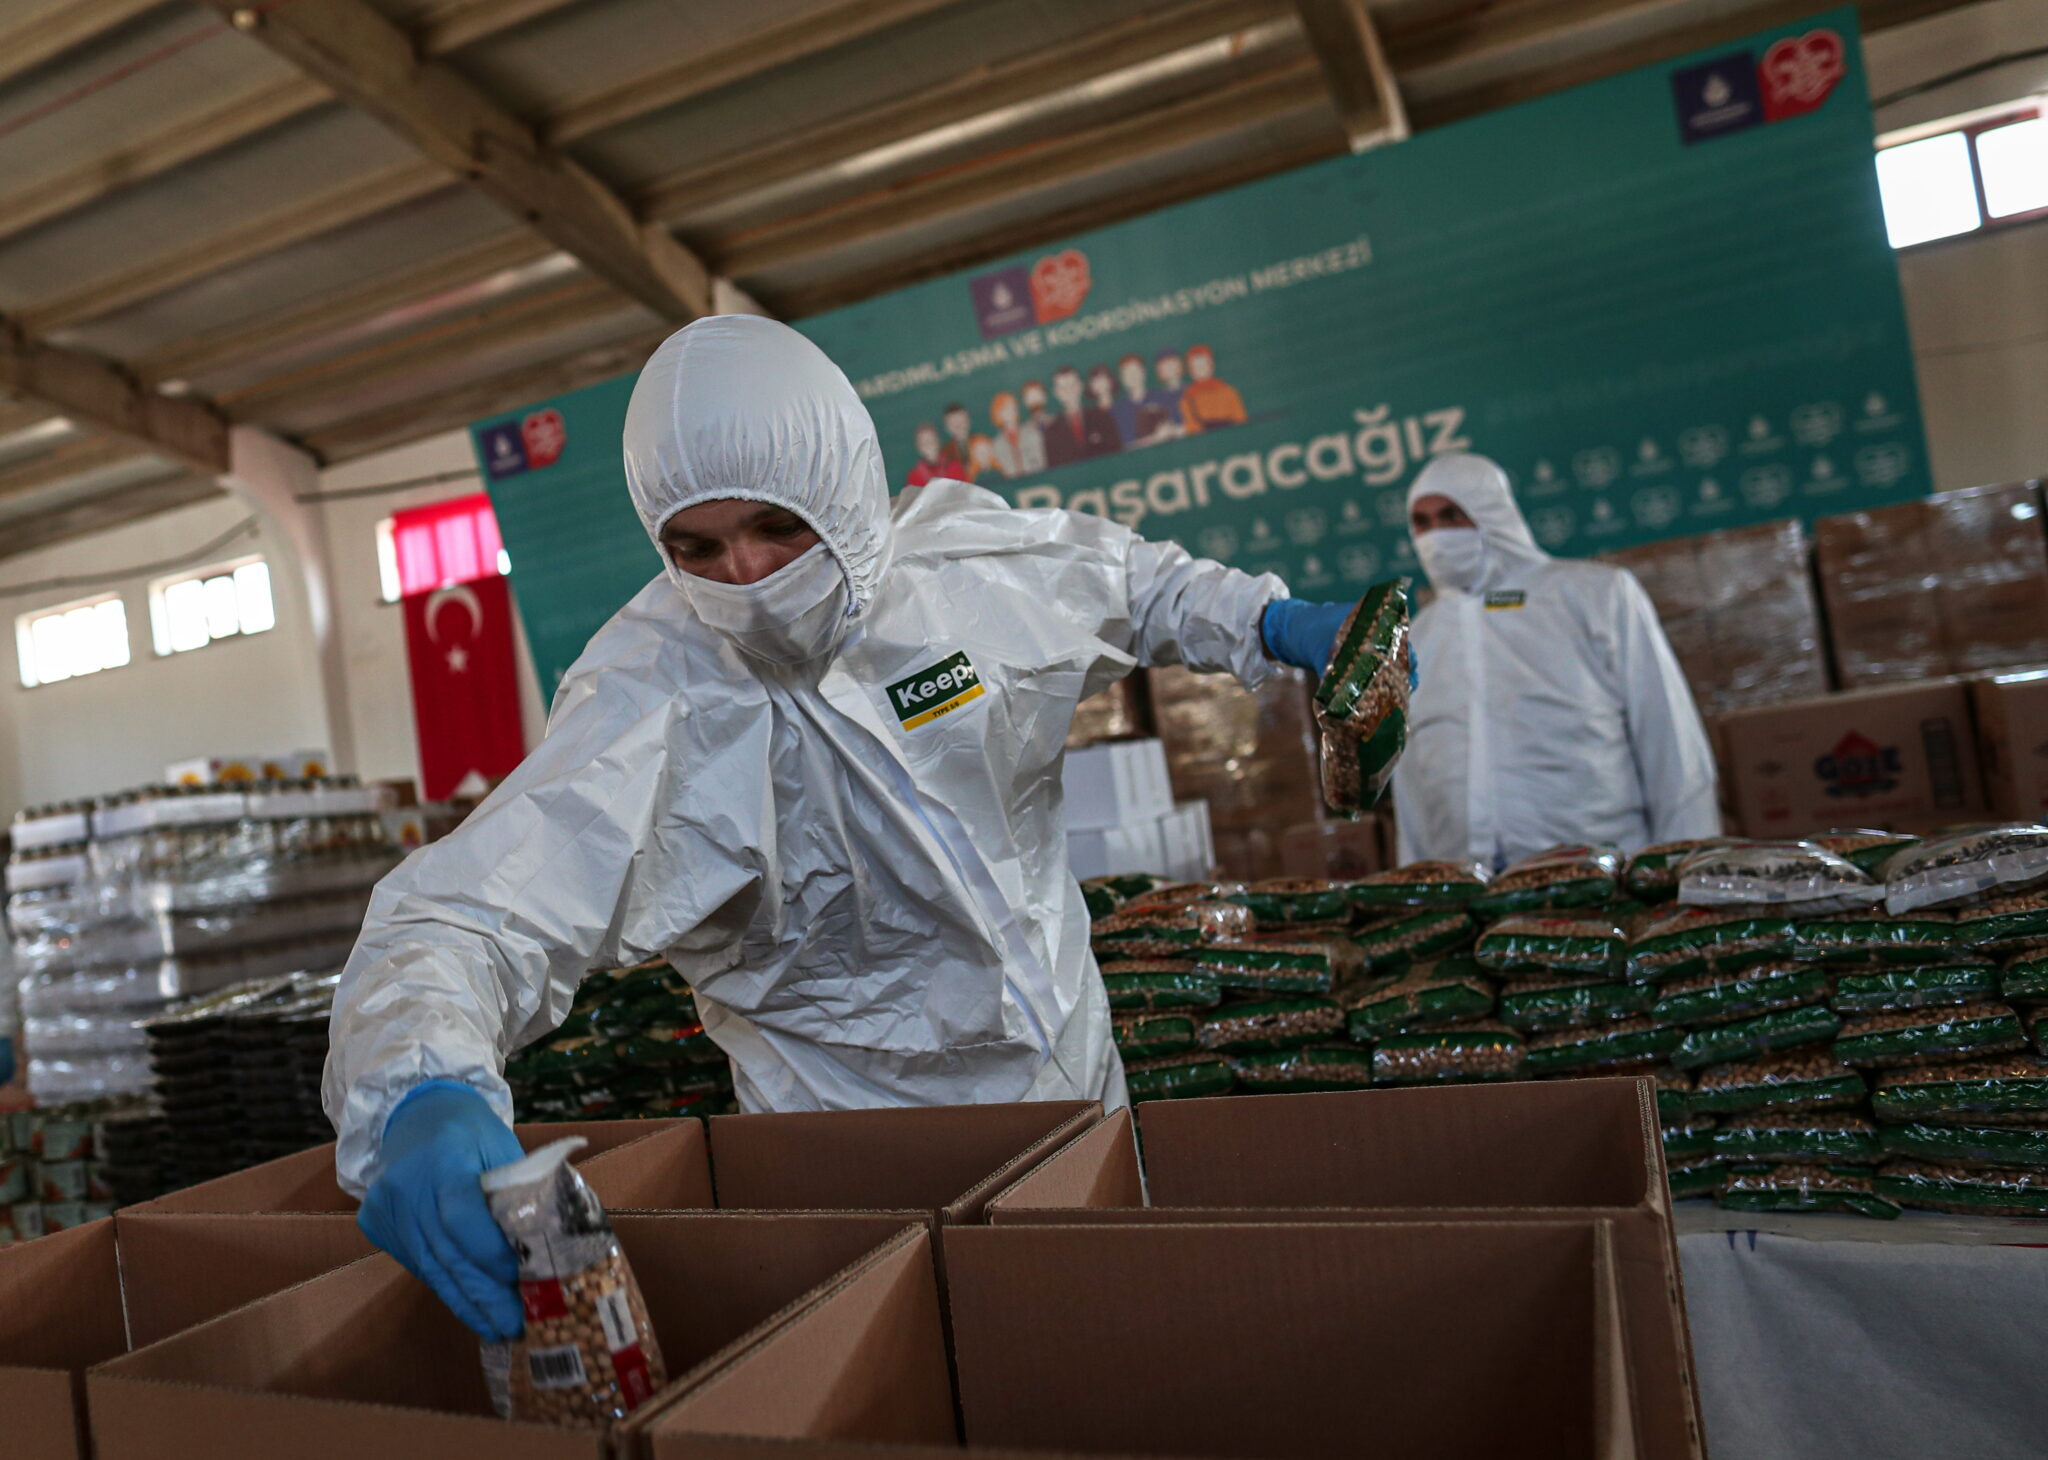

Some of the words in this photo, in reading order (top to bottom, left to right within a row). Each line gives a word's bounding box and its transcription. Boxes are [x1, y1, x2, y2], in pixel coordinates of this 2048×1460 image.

[854, 341, 1009, 398] ARDIMLAŞMA
[1008, 329, 1043, 357] VE
[1250, 234, 1372, 292] MERKEZİ
[896, 663, 969, 709] Keep
[932, 706, 950, 718] TYPE
